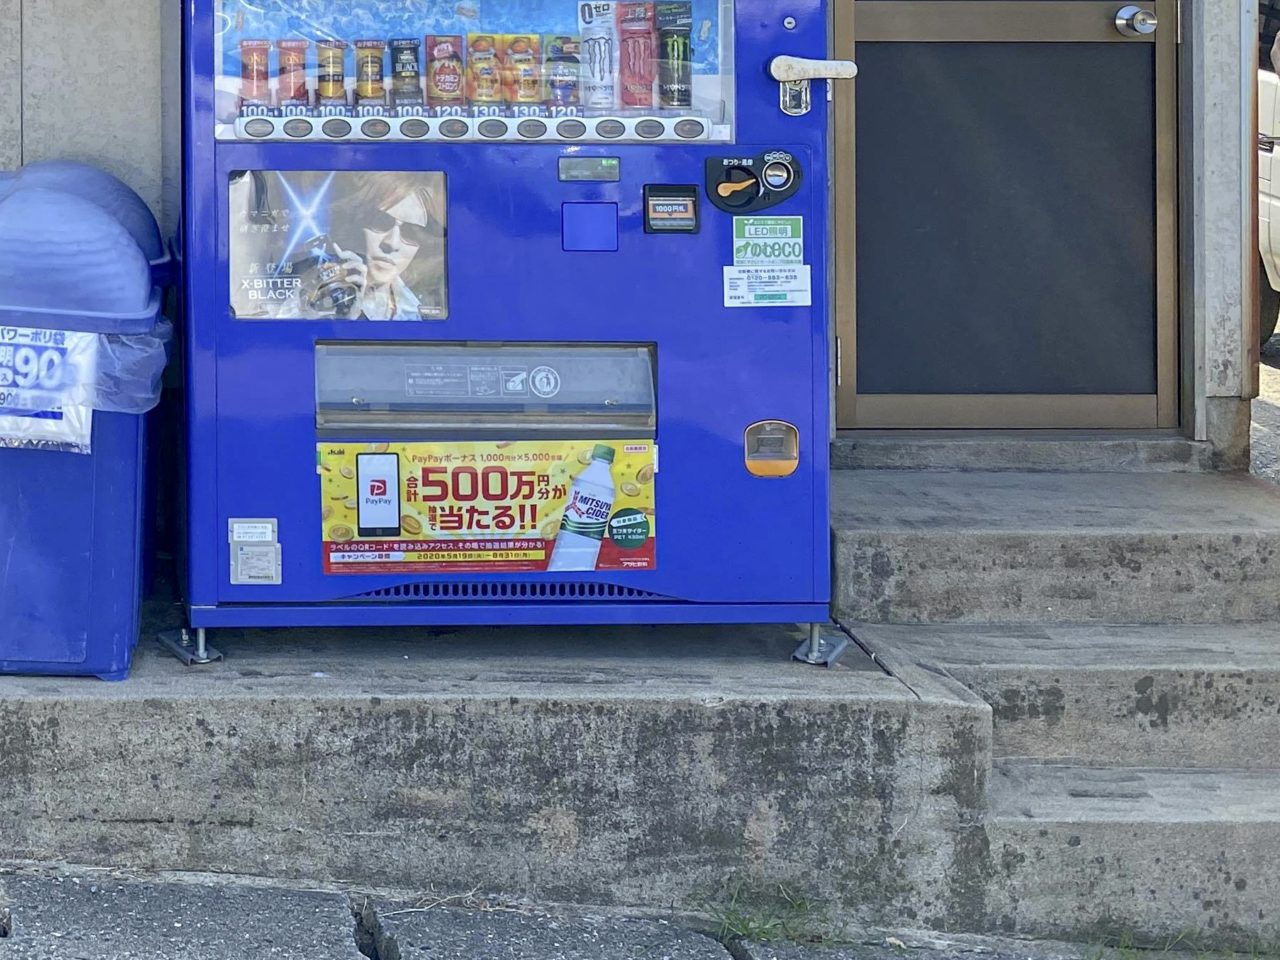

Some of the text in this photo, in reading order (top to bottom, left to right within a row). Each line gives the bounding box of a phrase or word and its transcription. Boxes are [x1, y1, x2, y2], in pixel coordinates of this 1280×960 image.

[748, 226, 788, 237] LED照明
[249, 290, 294, 300] BLACK
[14, 347, 62, 388] 90
[412, 454, 476, 464] PayPayボーナス
[406, 475, 419, 502] 合計
[439, 504, 538, 530] 当たる!!
